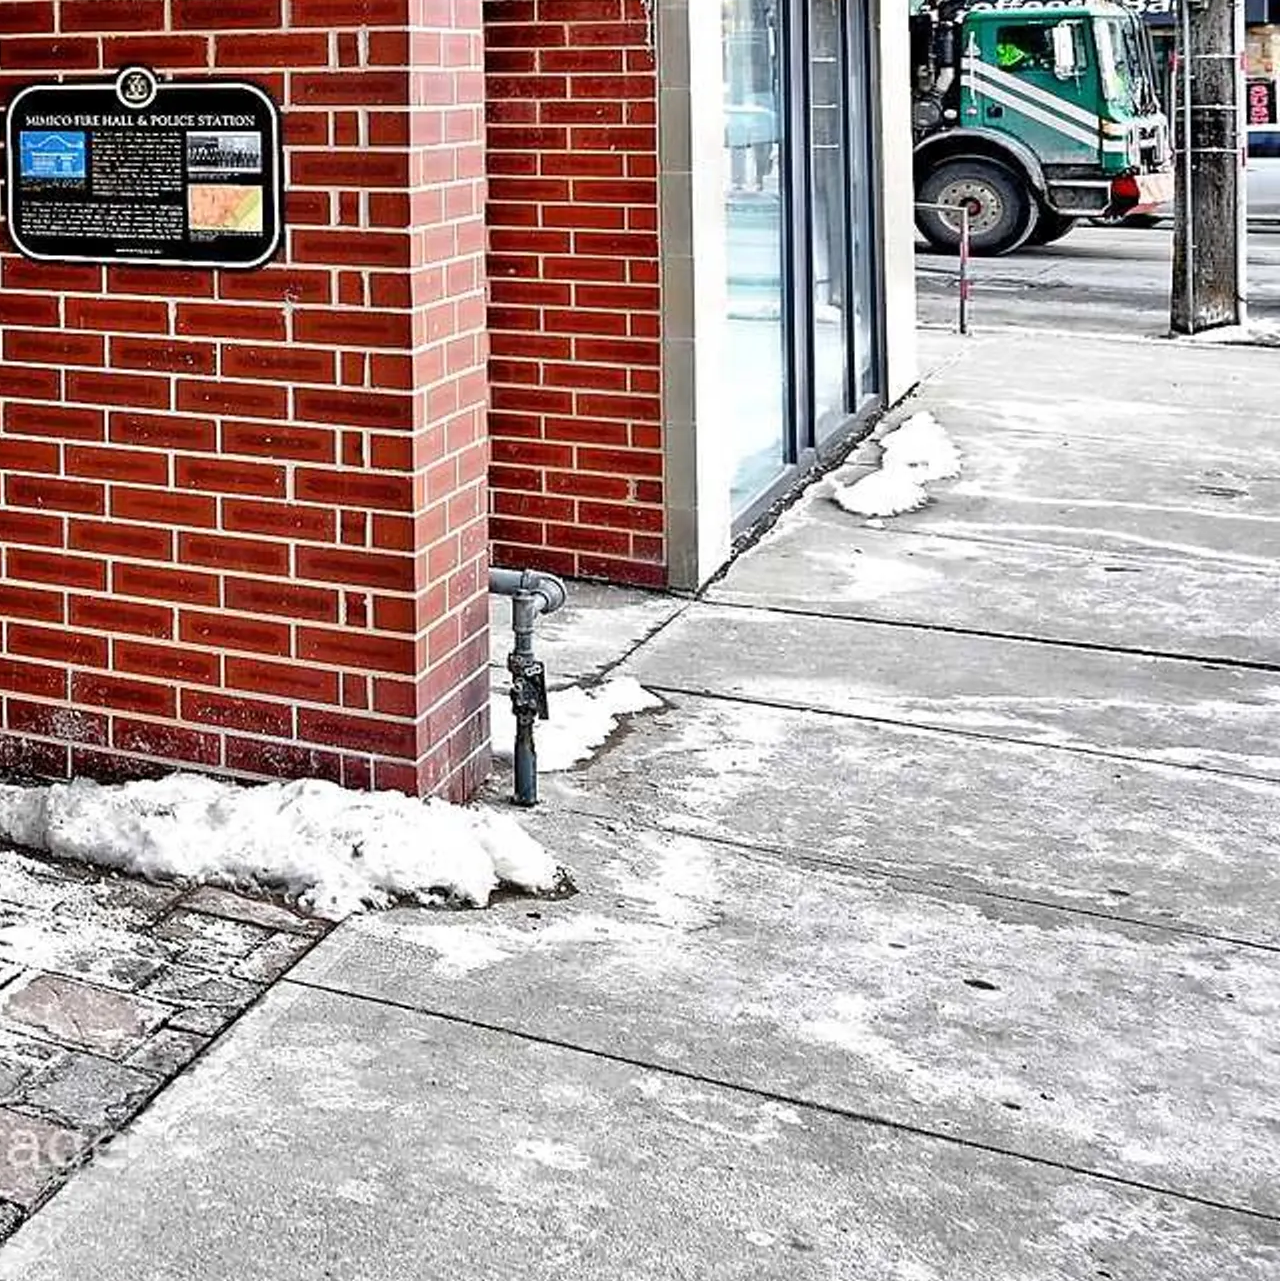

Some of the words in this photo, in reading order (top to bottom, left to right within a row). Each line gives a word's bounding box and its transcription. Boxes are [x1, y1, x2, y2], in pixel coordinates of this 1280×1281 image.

[73, 114, 101, 127] FIRE
[102, 114, 135, 127] HALL
[137, 114, 149, 127] &
[150, 114, 196, 127] POLICE
[197, 114, 256, 127] STATION
